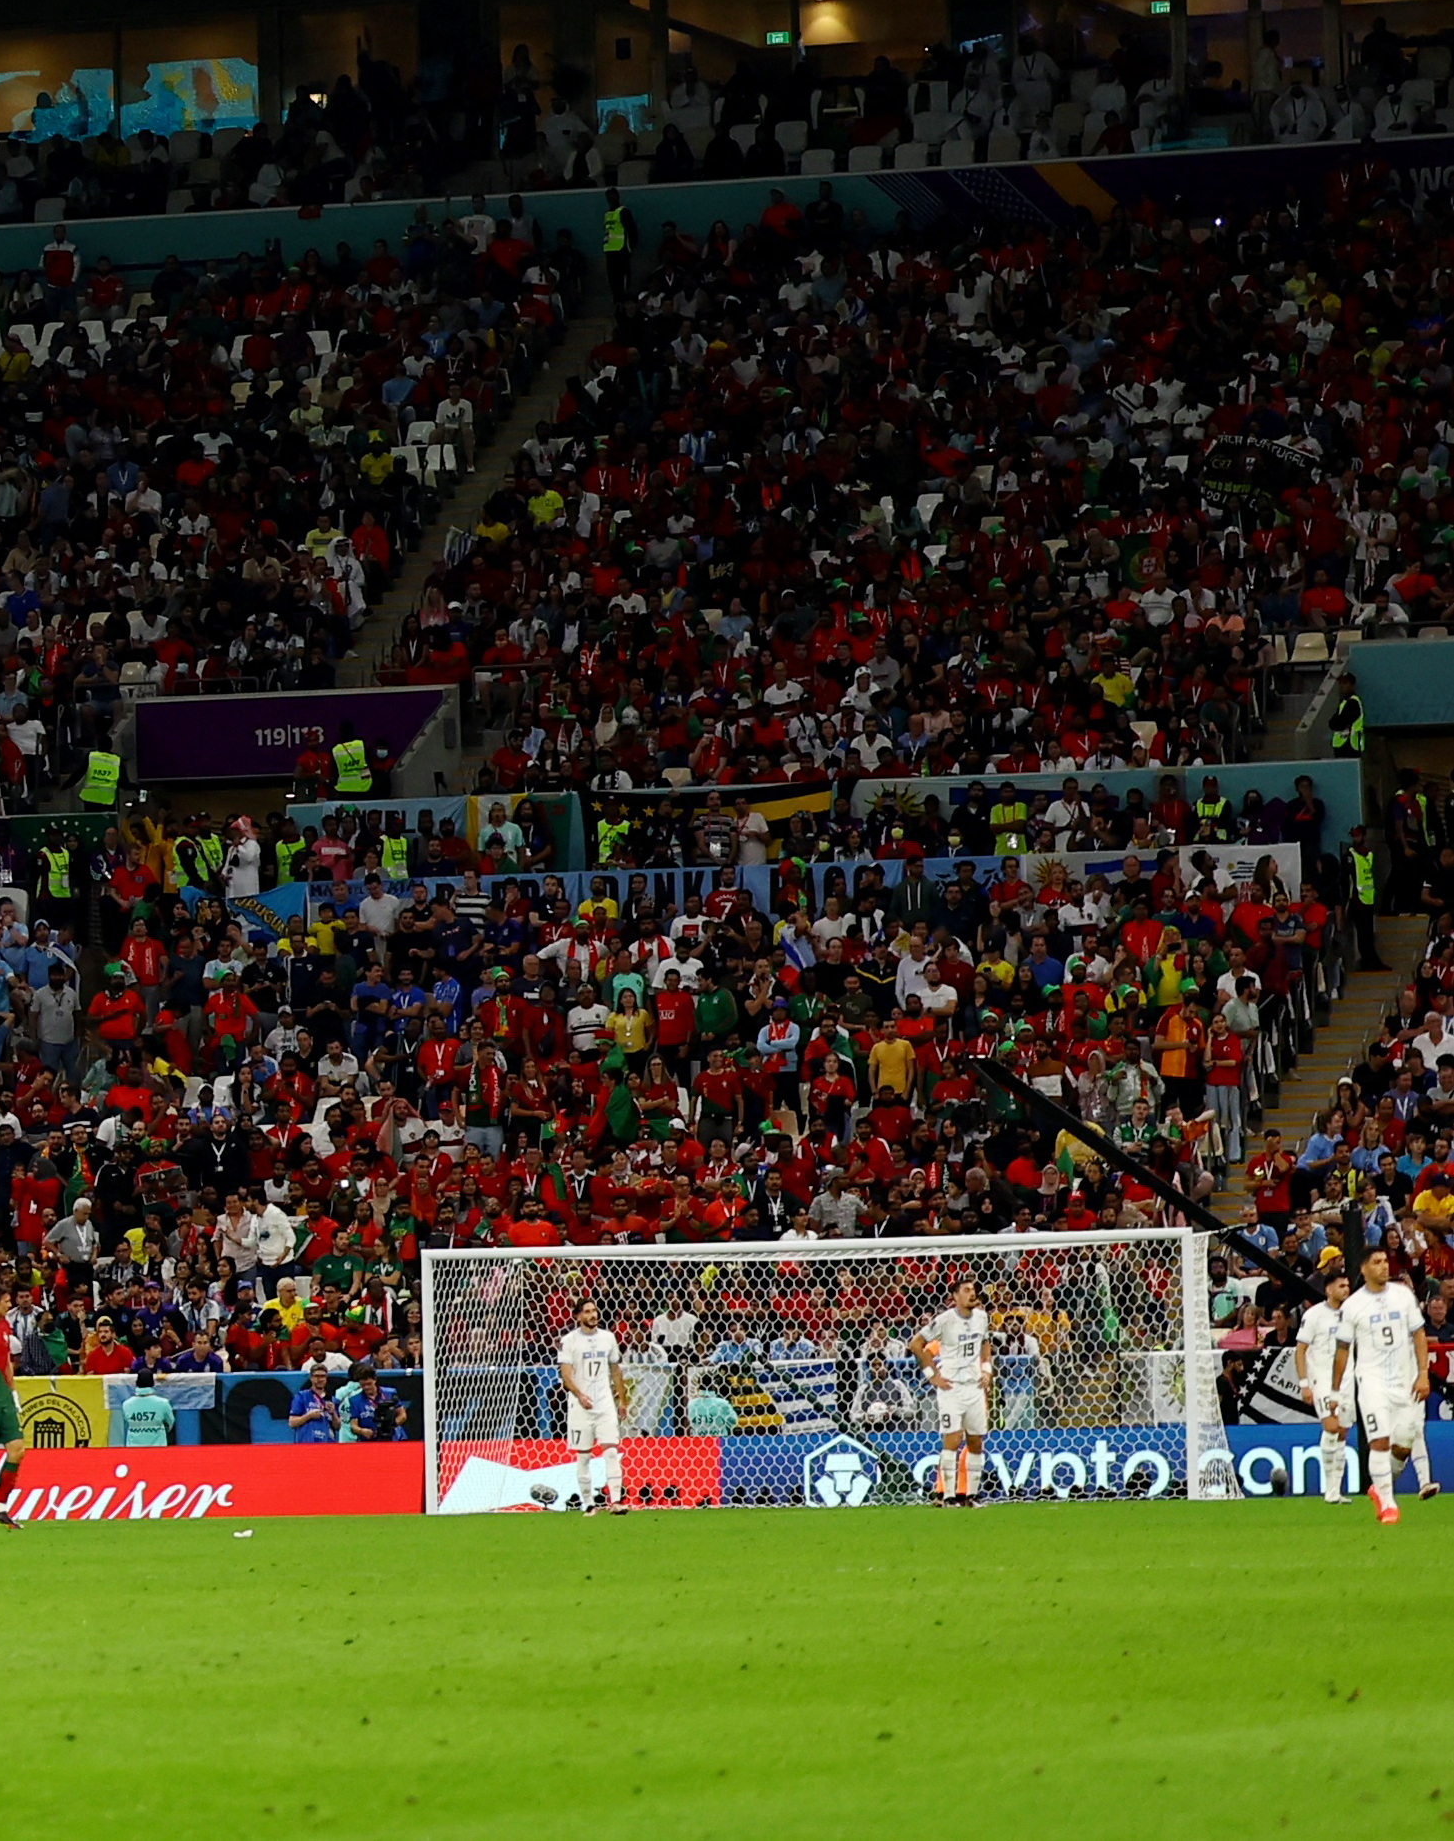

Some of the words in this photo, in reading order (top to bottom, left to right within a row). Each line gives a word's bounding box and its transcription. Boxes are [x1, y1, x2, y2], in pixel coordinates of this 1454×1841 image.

[1381, 1327, 1394, 1346] 9
[588, 1361, 601, 1377] 17
[1366, 1414, 1378, 1433] 9
